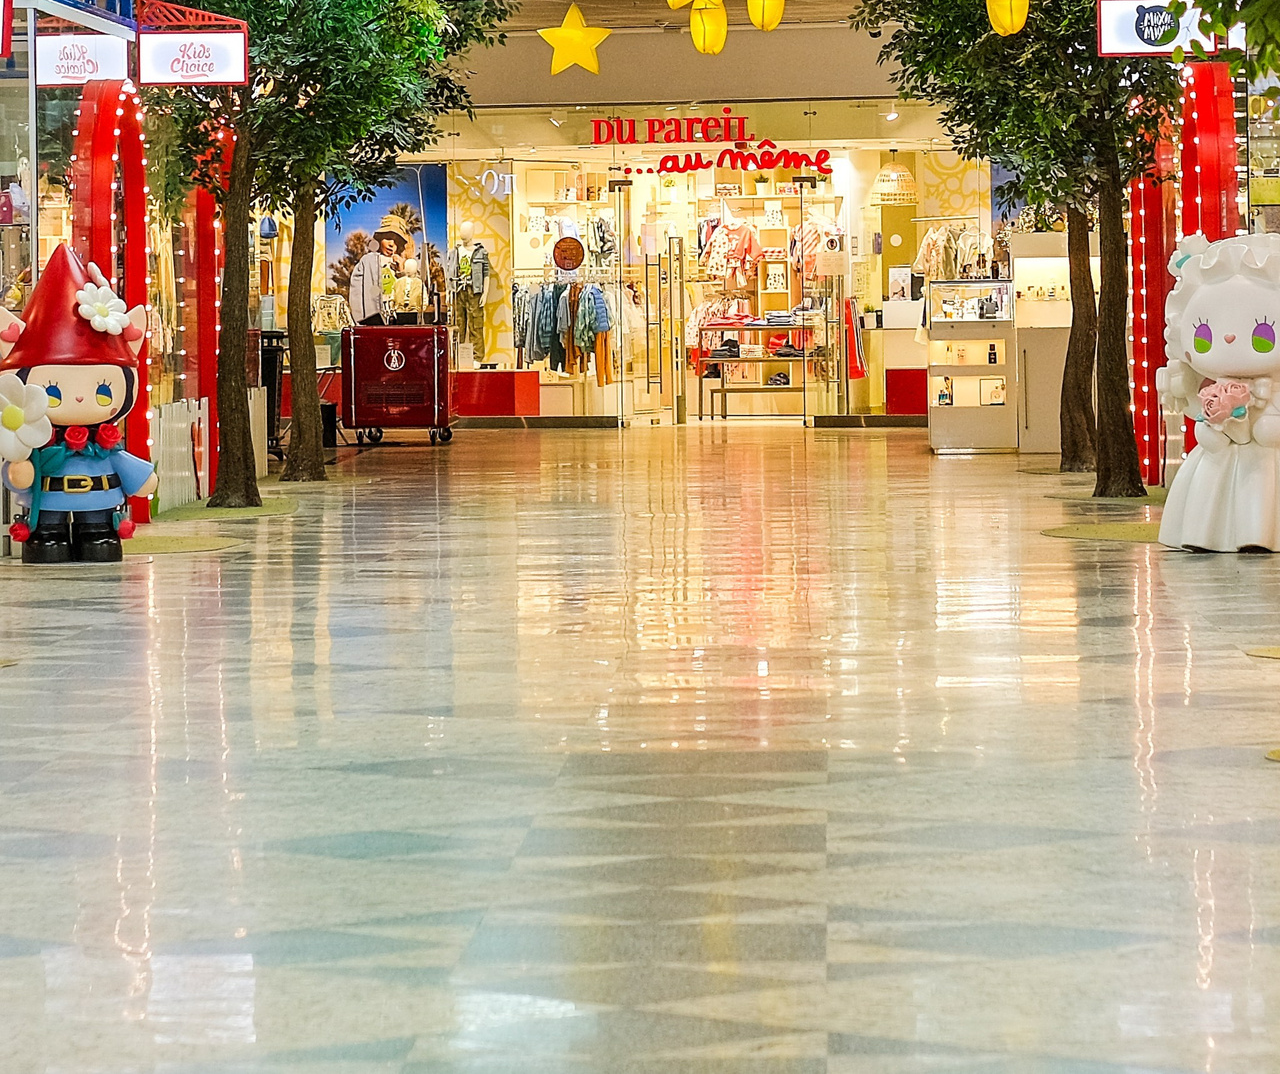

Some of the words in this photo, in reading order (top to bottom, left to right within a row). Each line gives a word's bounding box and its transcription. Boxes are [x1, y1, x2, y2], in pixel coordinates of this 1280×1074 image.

[179, 41, 211, 60] Kids
[170, 57, 215, 74] Choice
[717, 139, 834, 175] même
